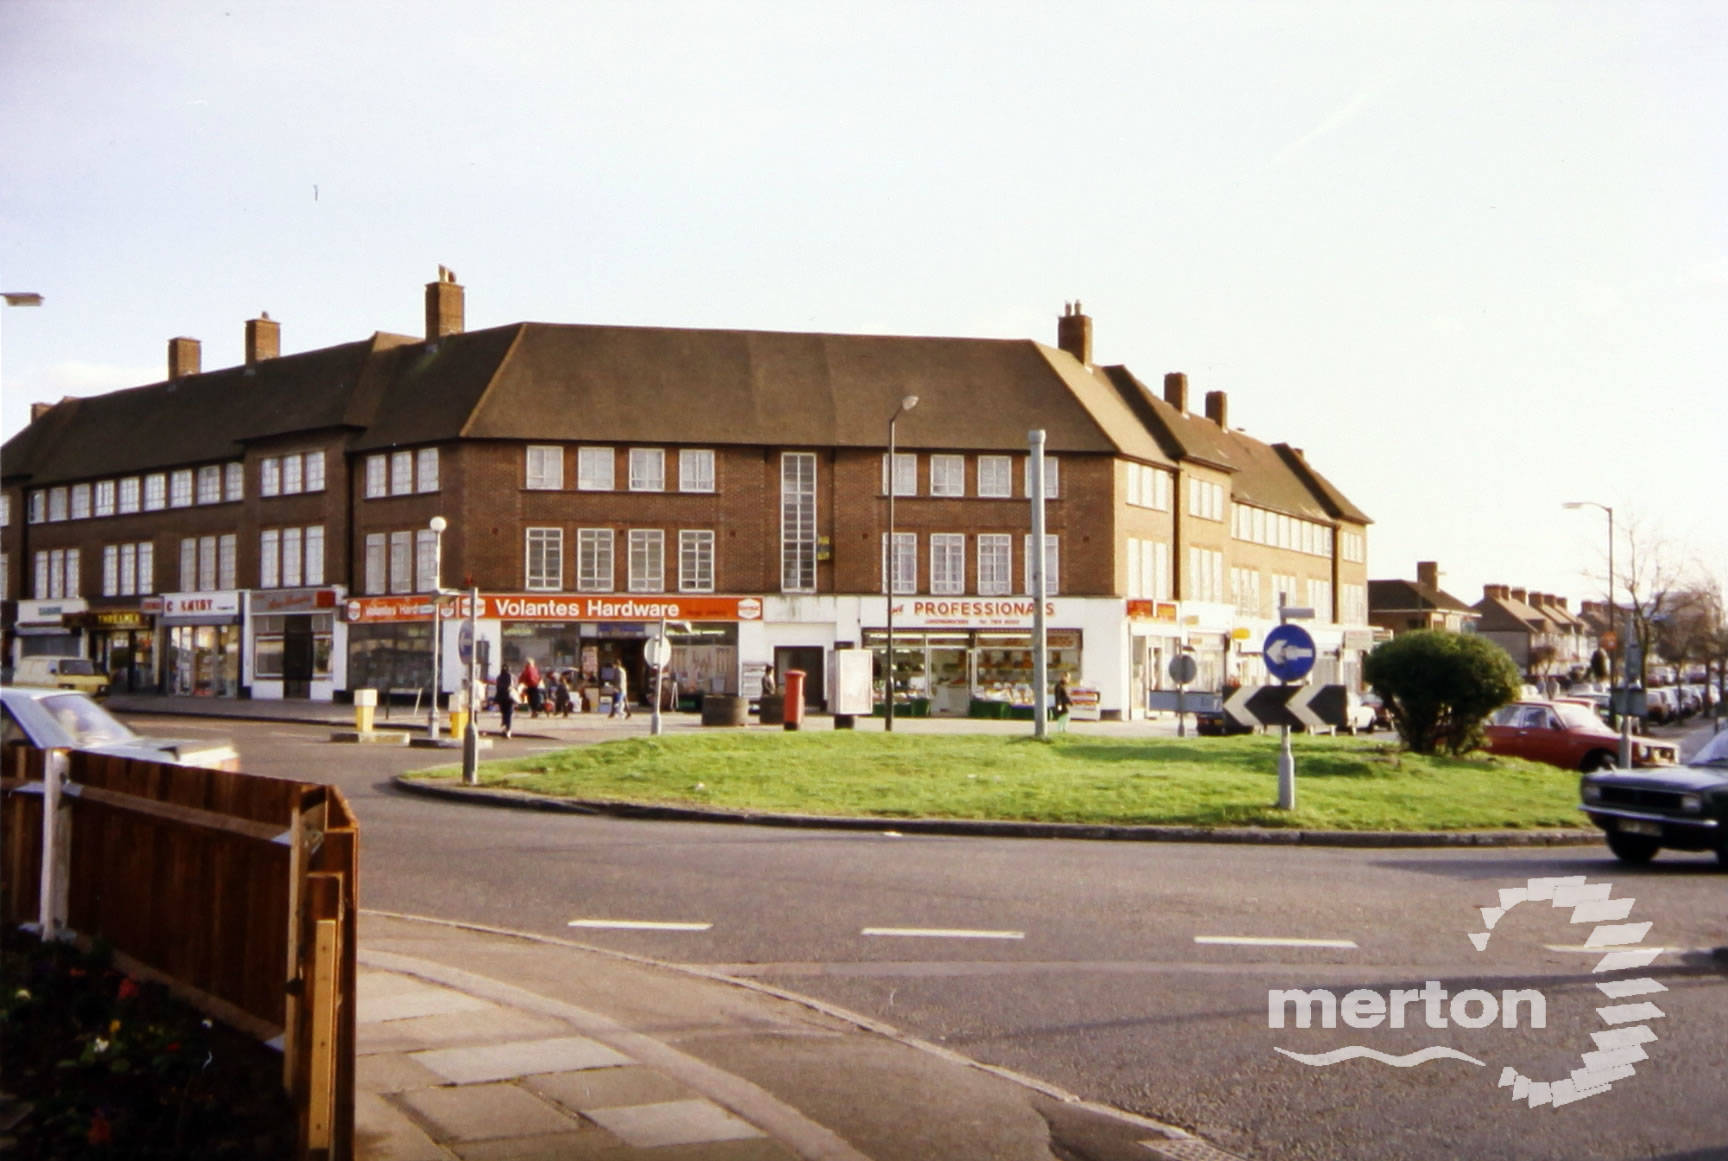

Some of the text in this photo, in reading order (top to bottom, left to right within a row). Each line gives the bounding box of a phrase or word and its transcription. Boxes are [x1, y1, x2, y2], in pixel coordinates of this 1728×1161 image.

[495, 599, 680, 617] Volantes Hardware
[914, 601, 1055, 616] PROFESSIONAS
